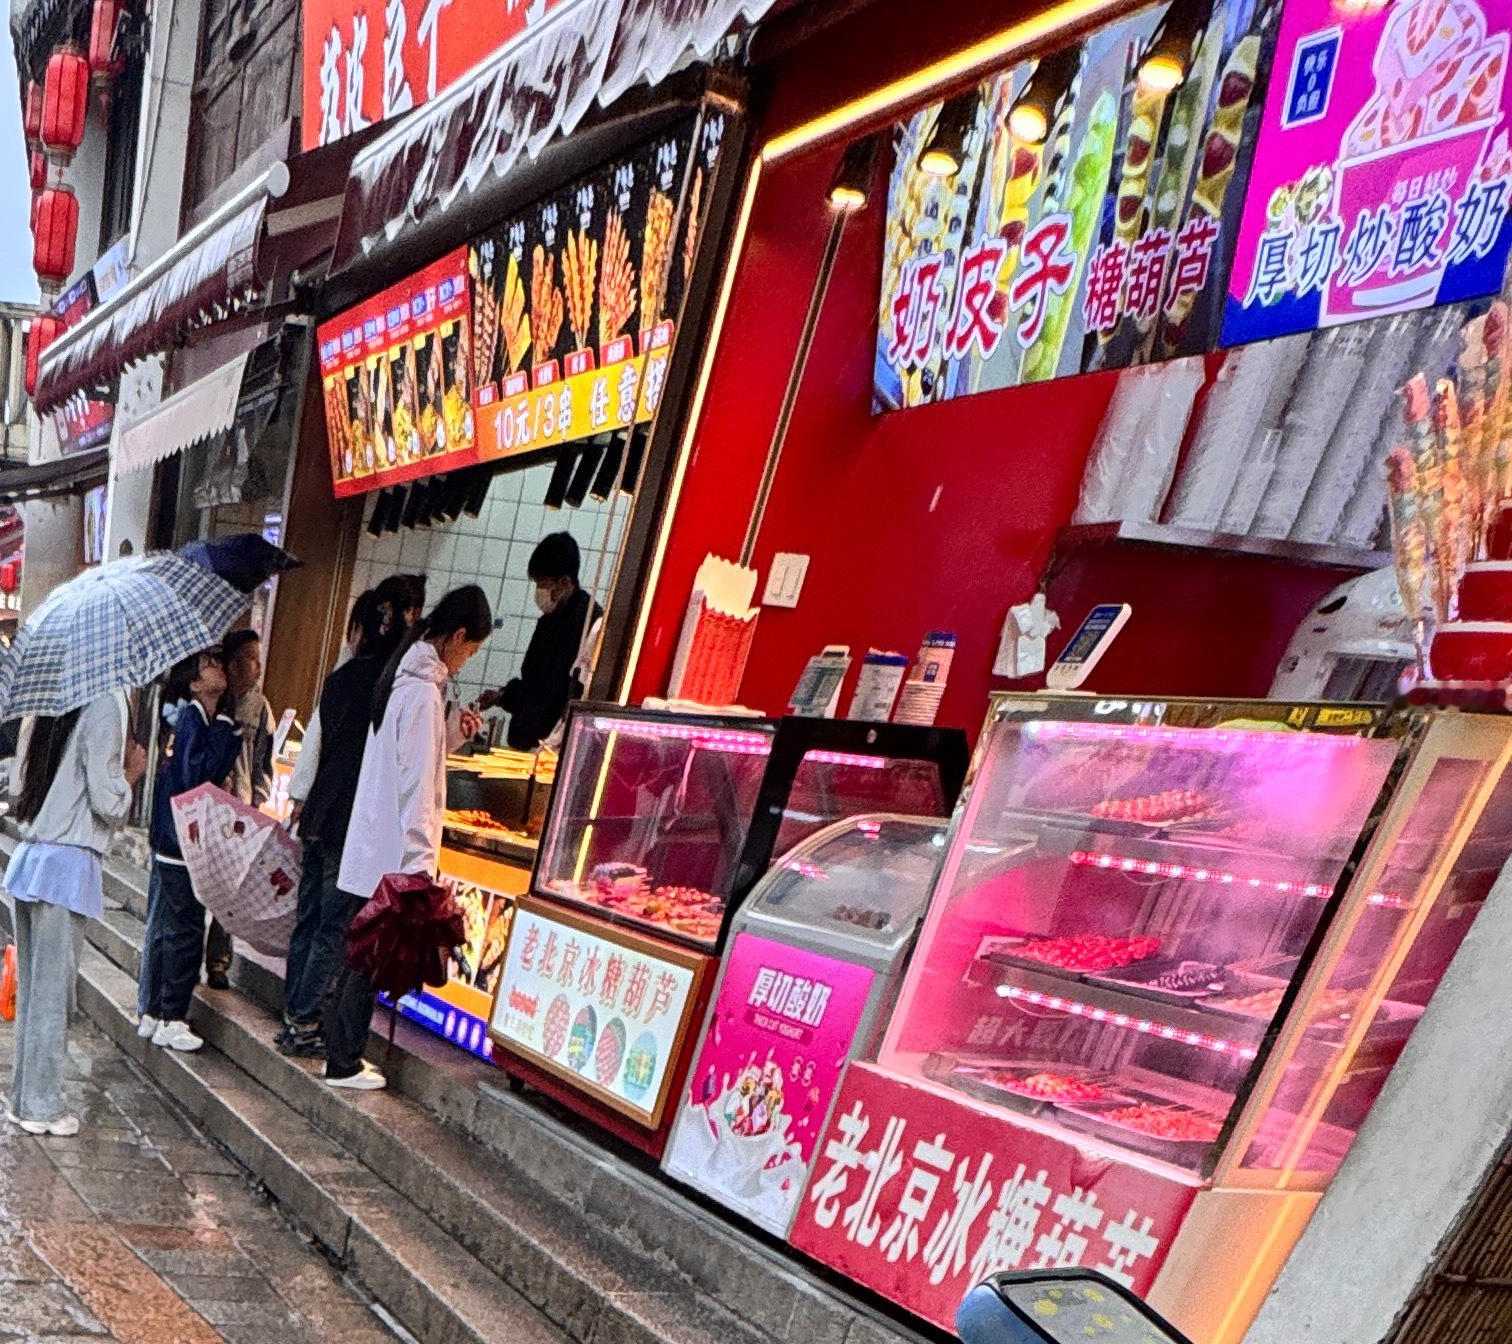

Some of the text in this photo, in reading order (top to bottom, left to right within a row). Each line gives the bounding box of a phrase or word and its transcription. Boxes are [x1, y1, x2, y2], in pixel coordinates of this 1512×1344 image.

[888, 214, 1221, 368] 奶皮子 糖葫芦
[1243, 180, 1510, 308] 厚切炒酸奶
[494, 388, 572, 450] 10元/3串
[520, 923, 678, 1024] 老北京冰糖葫芦
[747, 966, 833, 1027] 厚切酸奶
